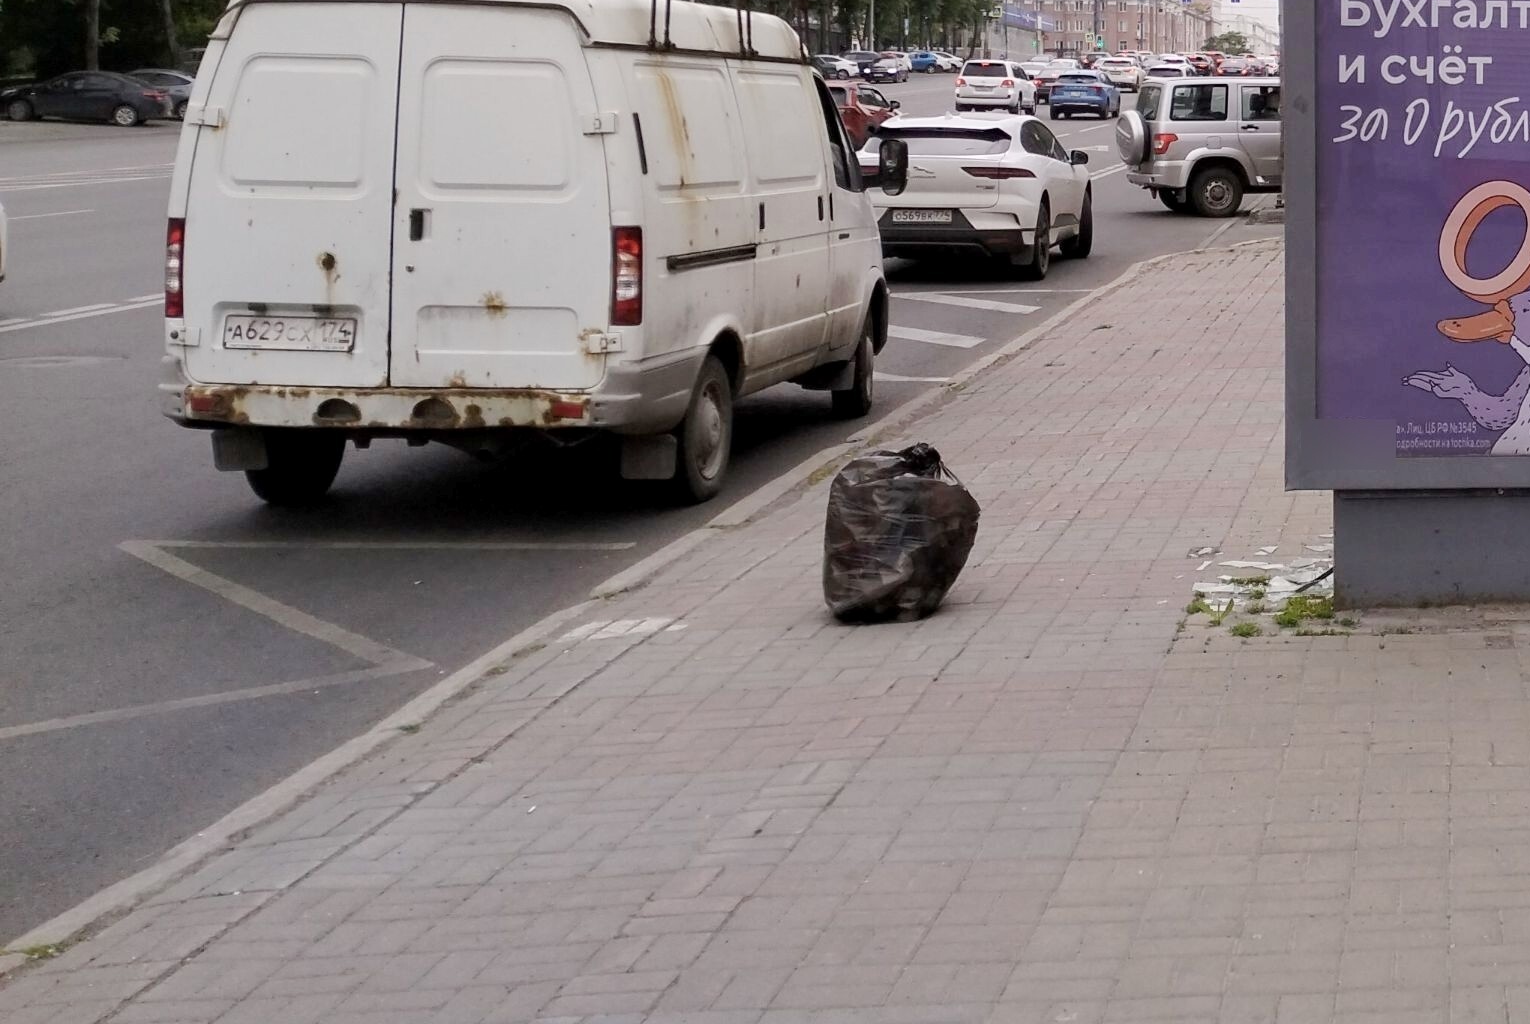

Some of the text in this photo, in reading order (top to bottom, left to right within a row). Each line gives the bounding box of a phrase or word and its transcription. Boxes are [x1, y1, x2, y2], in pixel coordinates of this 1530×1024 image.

[1338, 45, 1493, 85] и счёт
[1333, 105, 1389, 143] за
[1403, 98, 1429, 145] 0
